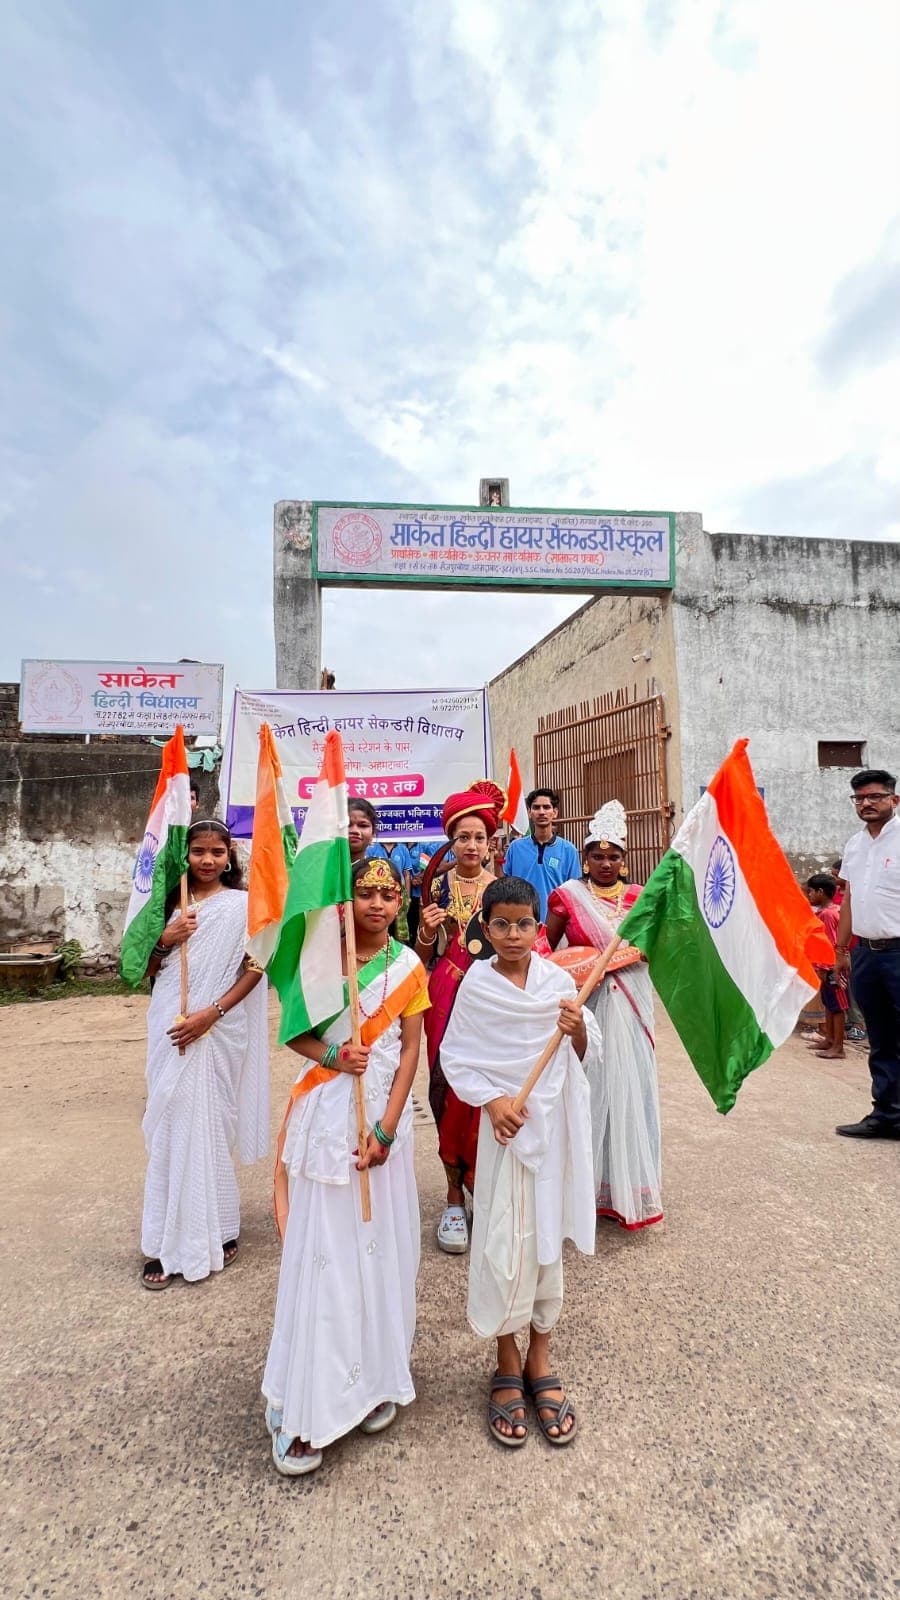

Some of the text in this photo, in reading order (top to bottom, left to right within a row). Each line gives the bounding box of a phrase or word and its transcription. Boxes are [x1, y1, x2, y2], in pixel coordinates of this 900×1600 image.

[390, 519, 448, 547] साकेत
[449, 520, 497, 550] हिन्दी
[498, 526, 545, 549] हायर
[616, 529, 666, 556] स्कूल
[97, 666, 184, 688] साकेत
[91, 690, 133, 709] हिन्दी
[257, 723, 296, 739] केत
[297, 716, 329, 736] हिन्दी
[332, 717, 364, 732] हायर
[367, 714, 415, 733] सेकन्डरी
[358, 738, 381, 753] स्टेशन
[383, 739, 393, 752] के
[354, 781, 368, 795] से
[372, 782, 389, 795] १२
[393, 779, 419, 793] तक
